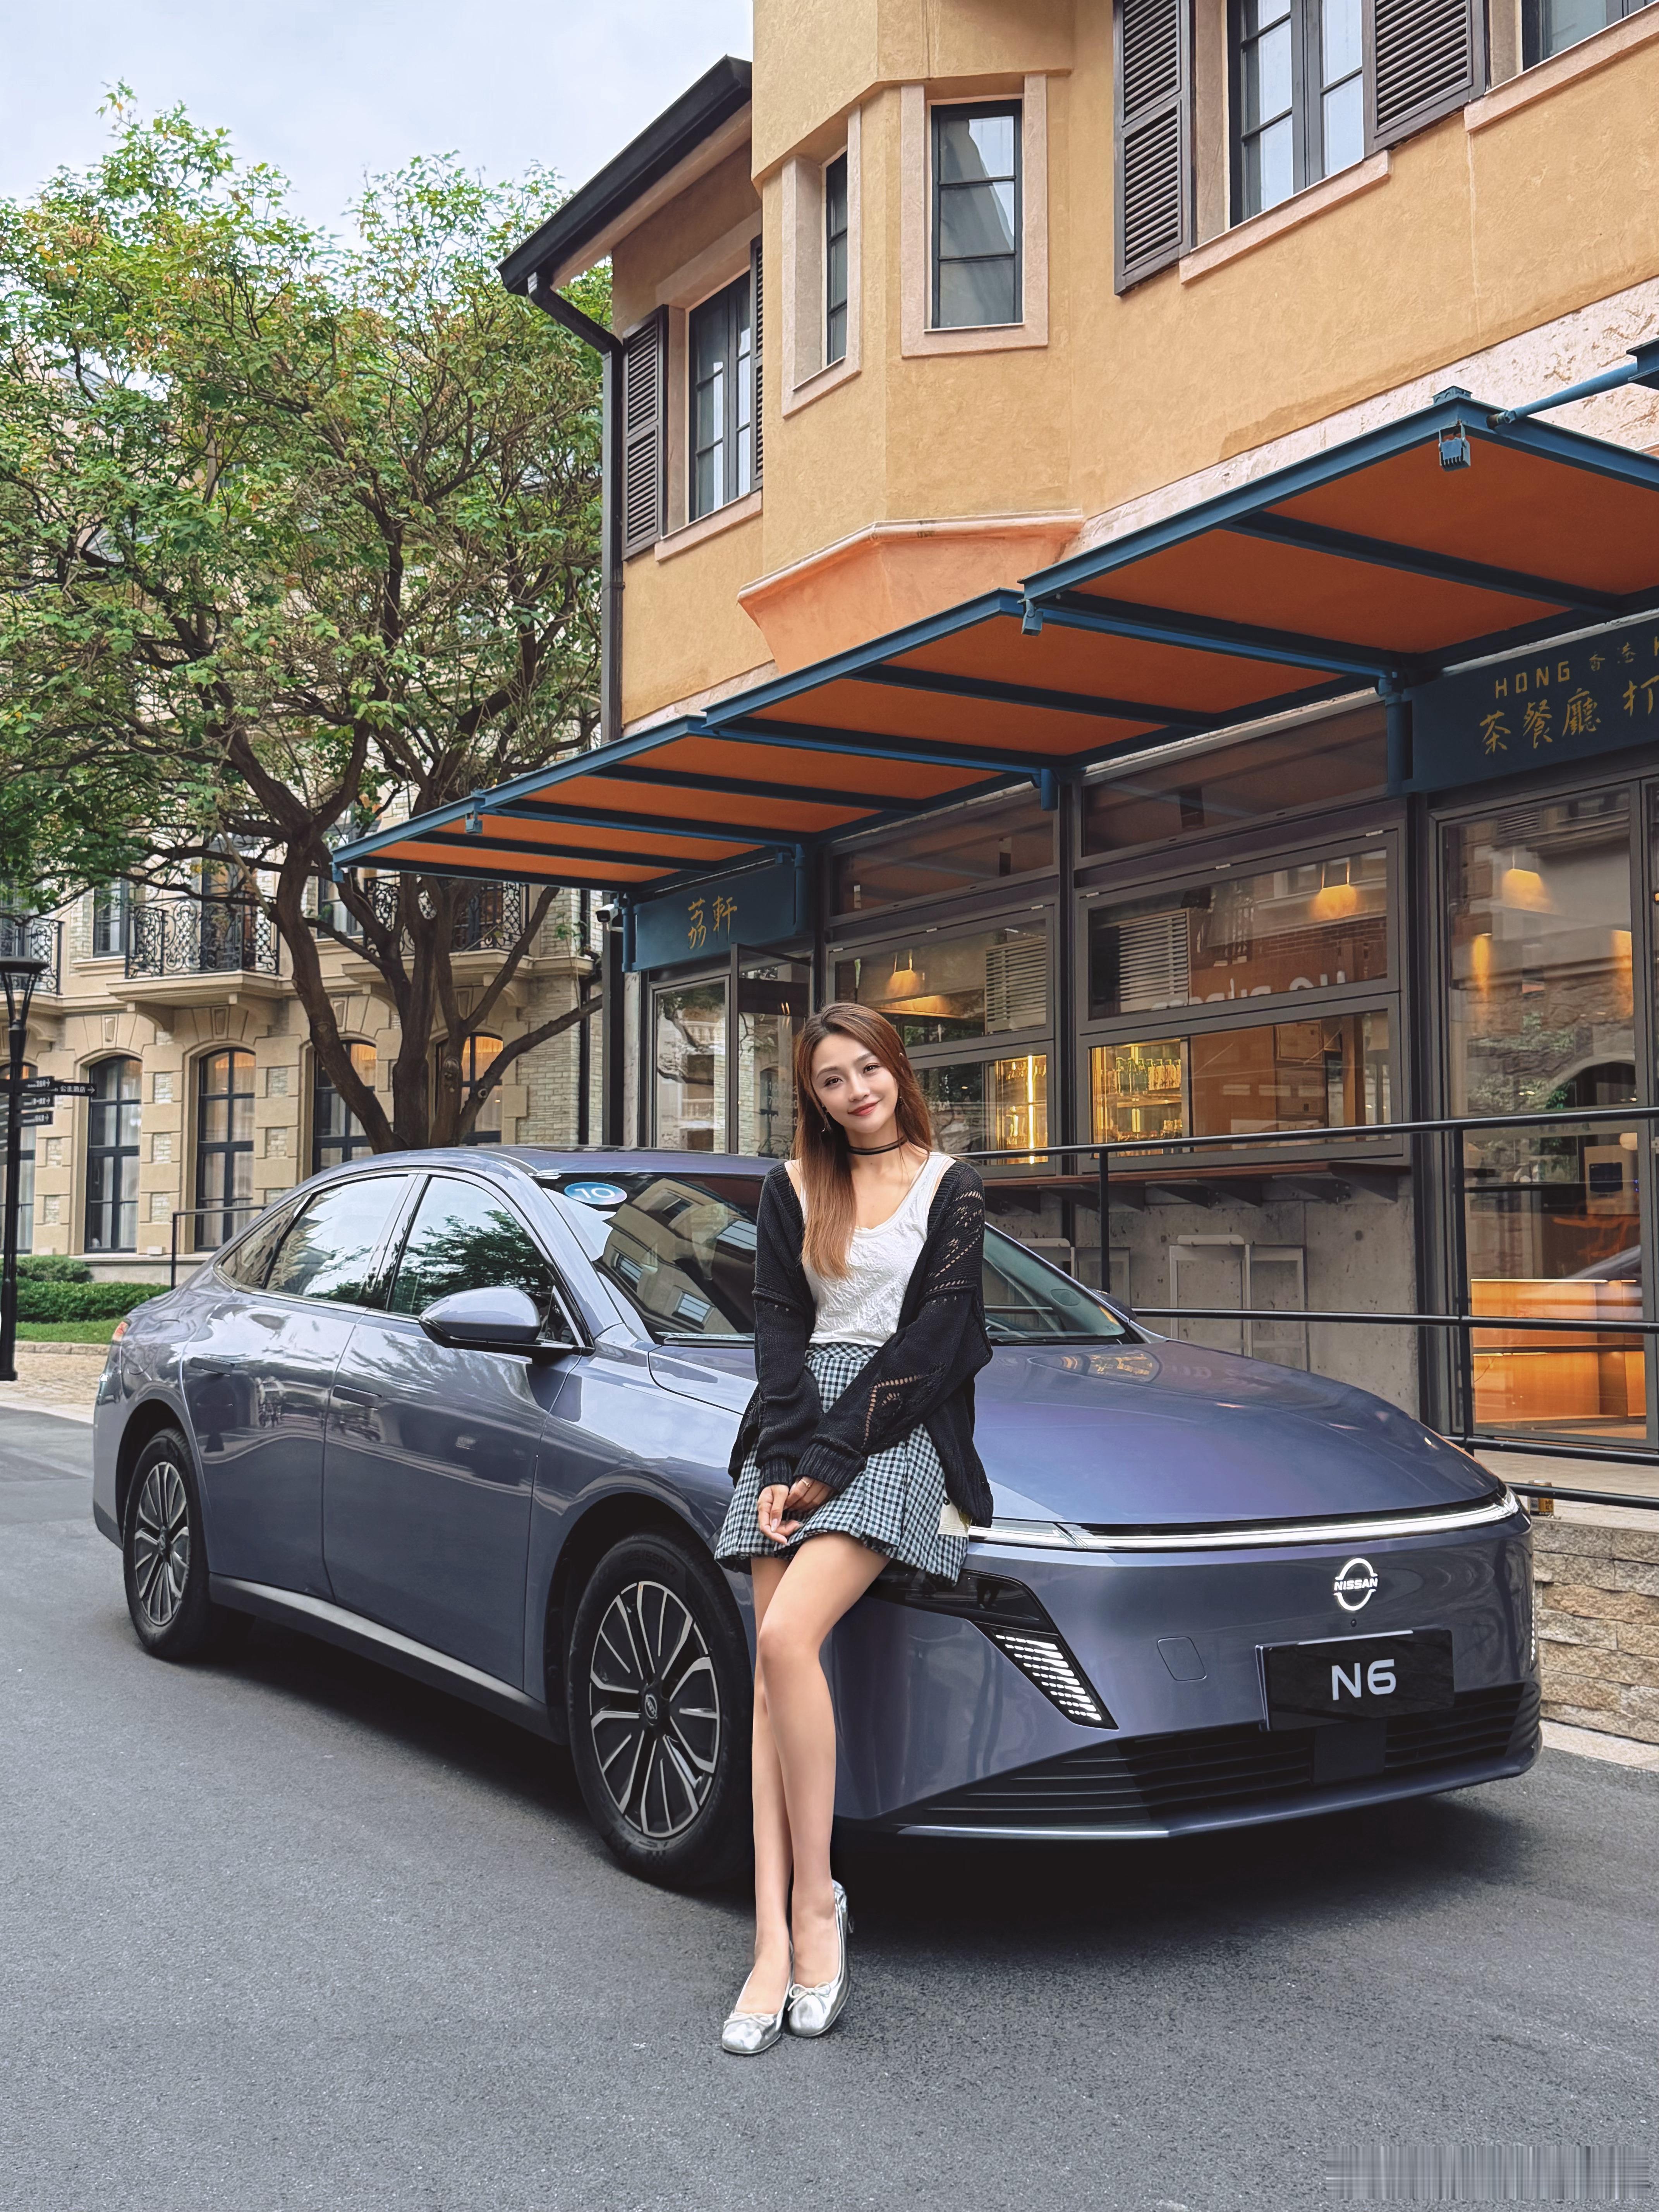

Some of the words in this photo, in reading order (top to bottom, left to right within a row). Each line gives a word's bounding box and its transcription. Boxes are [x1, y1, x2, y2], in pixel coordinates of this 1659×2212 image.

[1496, 661, 1570, 699] HONG
[574, 1187, 616, 1199] 10
[1334, 1578, 1378, 1591] NISSAN
[1331, 1659, 1396, 1700] N6
